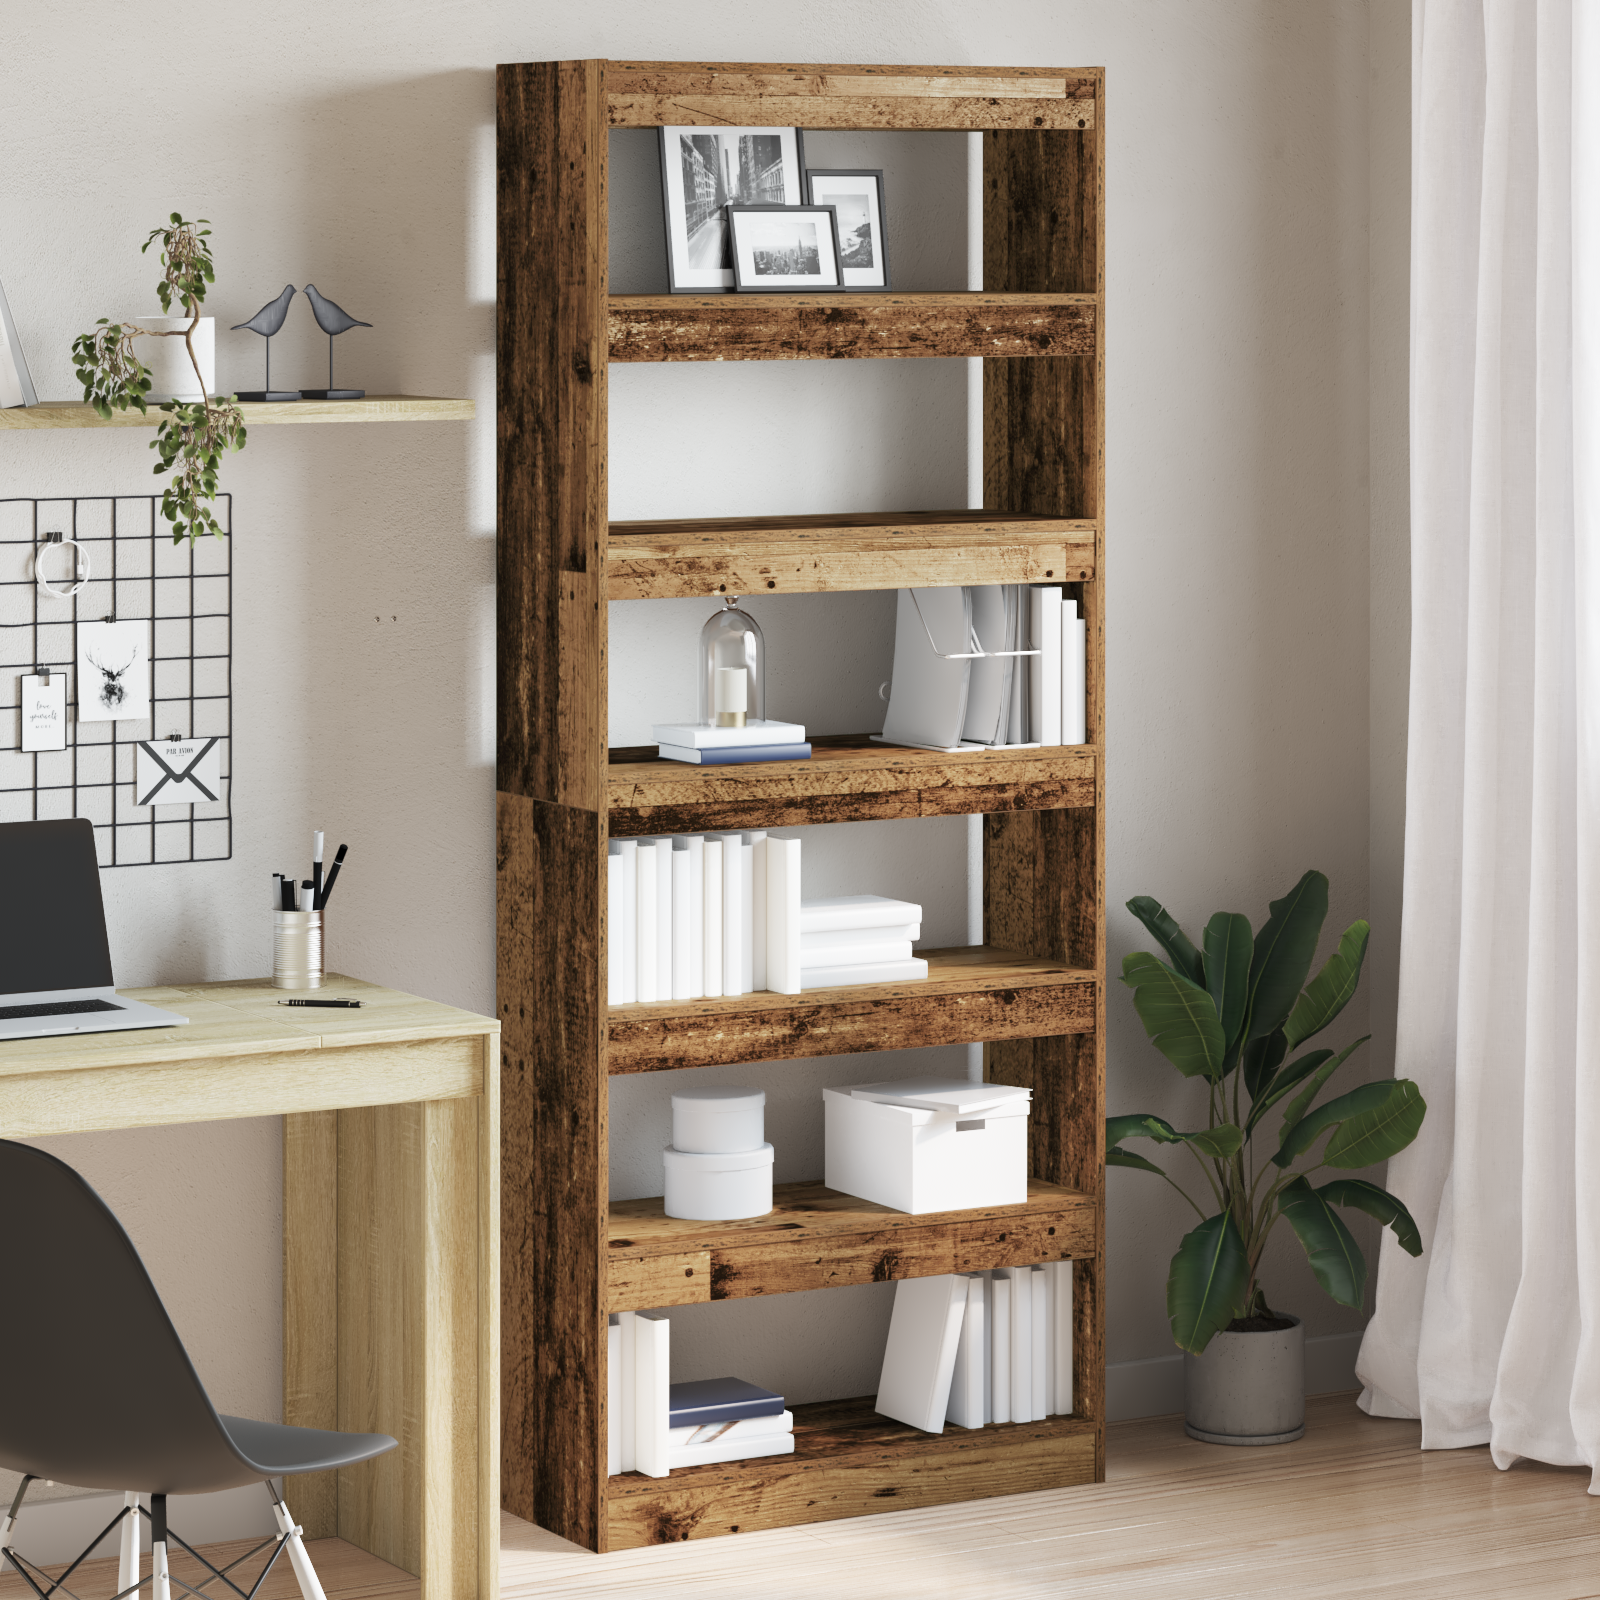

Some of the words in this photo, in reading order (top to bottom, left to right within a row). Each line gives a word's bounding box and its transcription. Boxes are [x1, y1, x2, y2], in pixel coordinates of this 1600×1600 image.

[36, 700, 51, 711] love
[29, 709, 58, 723] yourself
[179, 747, 194, 755] AVION
